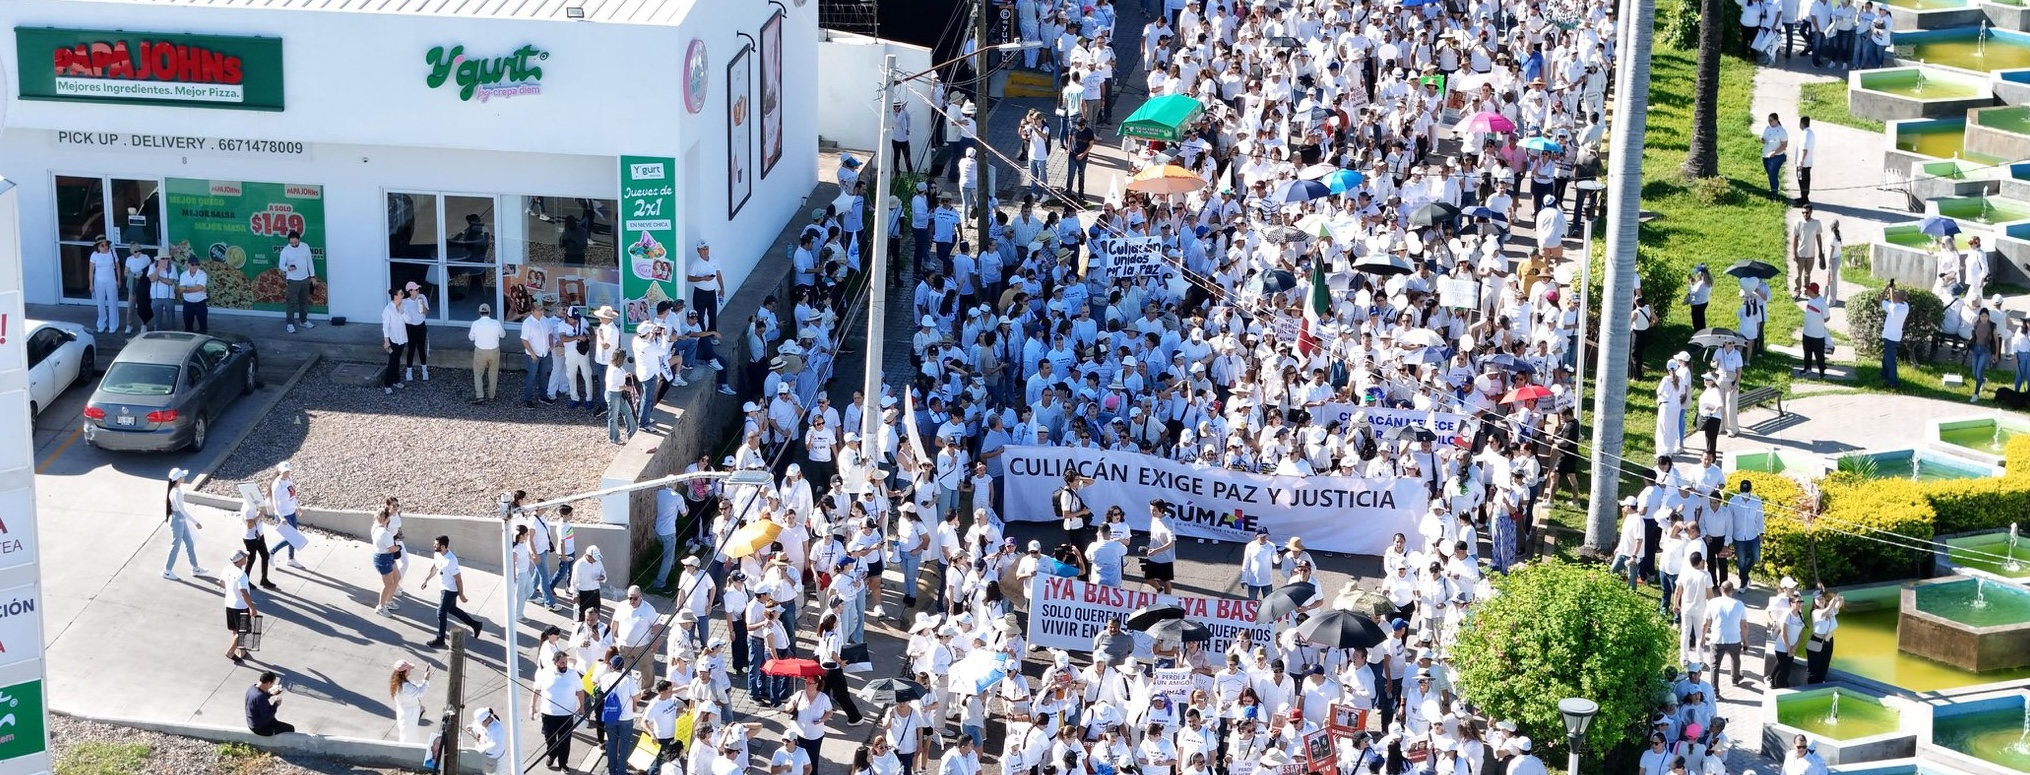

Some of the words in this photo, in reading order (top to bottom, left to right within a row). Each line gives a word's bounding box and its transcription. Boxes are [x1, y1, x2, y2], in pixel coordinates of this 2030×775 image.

[58, 81, 101, 92] Mejores
[103, 83, 173, 95] Ingredientes.
[175, 86, 207, 98] Mejor
[209, 87, 240, 98] Pizza.
[493, 87, 518, 98] crepa
[519, 86, 540, 95] diem
[58, 131, 95, 145] PICK
[98, 133, 119, 146] UP
[131, 135, 206, 150] DELIVERY
[218, 138, 303, 154] 6671478009
[623, 187, 659, 199] Jueves
[660, 185, 673, 196] de
[182, 209, 210, 218] MEJOR
[210, 210, 236, 219] SALSA
[633, 198, 663, 217] 2x1
[251, 213, 304, 236] $149
[1114, 254, 1149, 266] unidos
[1123, 265, 1135, 276] la
[1010, 457, 1128, 483] CULIACÁN
[1139, 467, 1204, 496] EXIGE
[1213, 481, 1258, 504] PAZ
[1267, 487, 1282, 505] Y
[1290, 489, 1396, 510] JUSTICIA
[1043, 577, 1075, 601] ¡YA
[1042, 604, 1072, 619] SOLO
[1042, 619, 1078, 637] VIVIR
[1082, 623, 1099, 639] EN
[1214, 639, 1232, 654] EN
